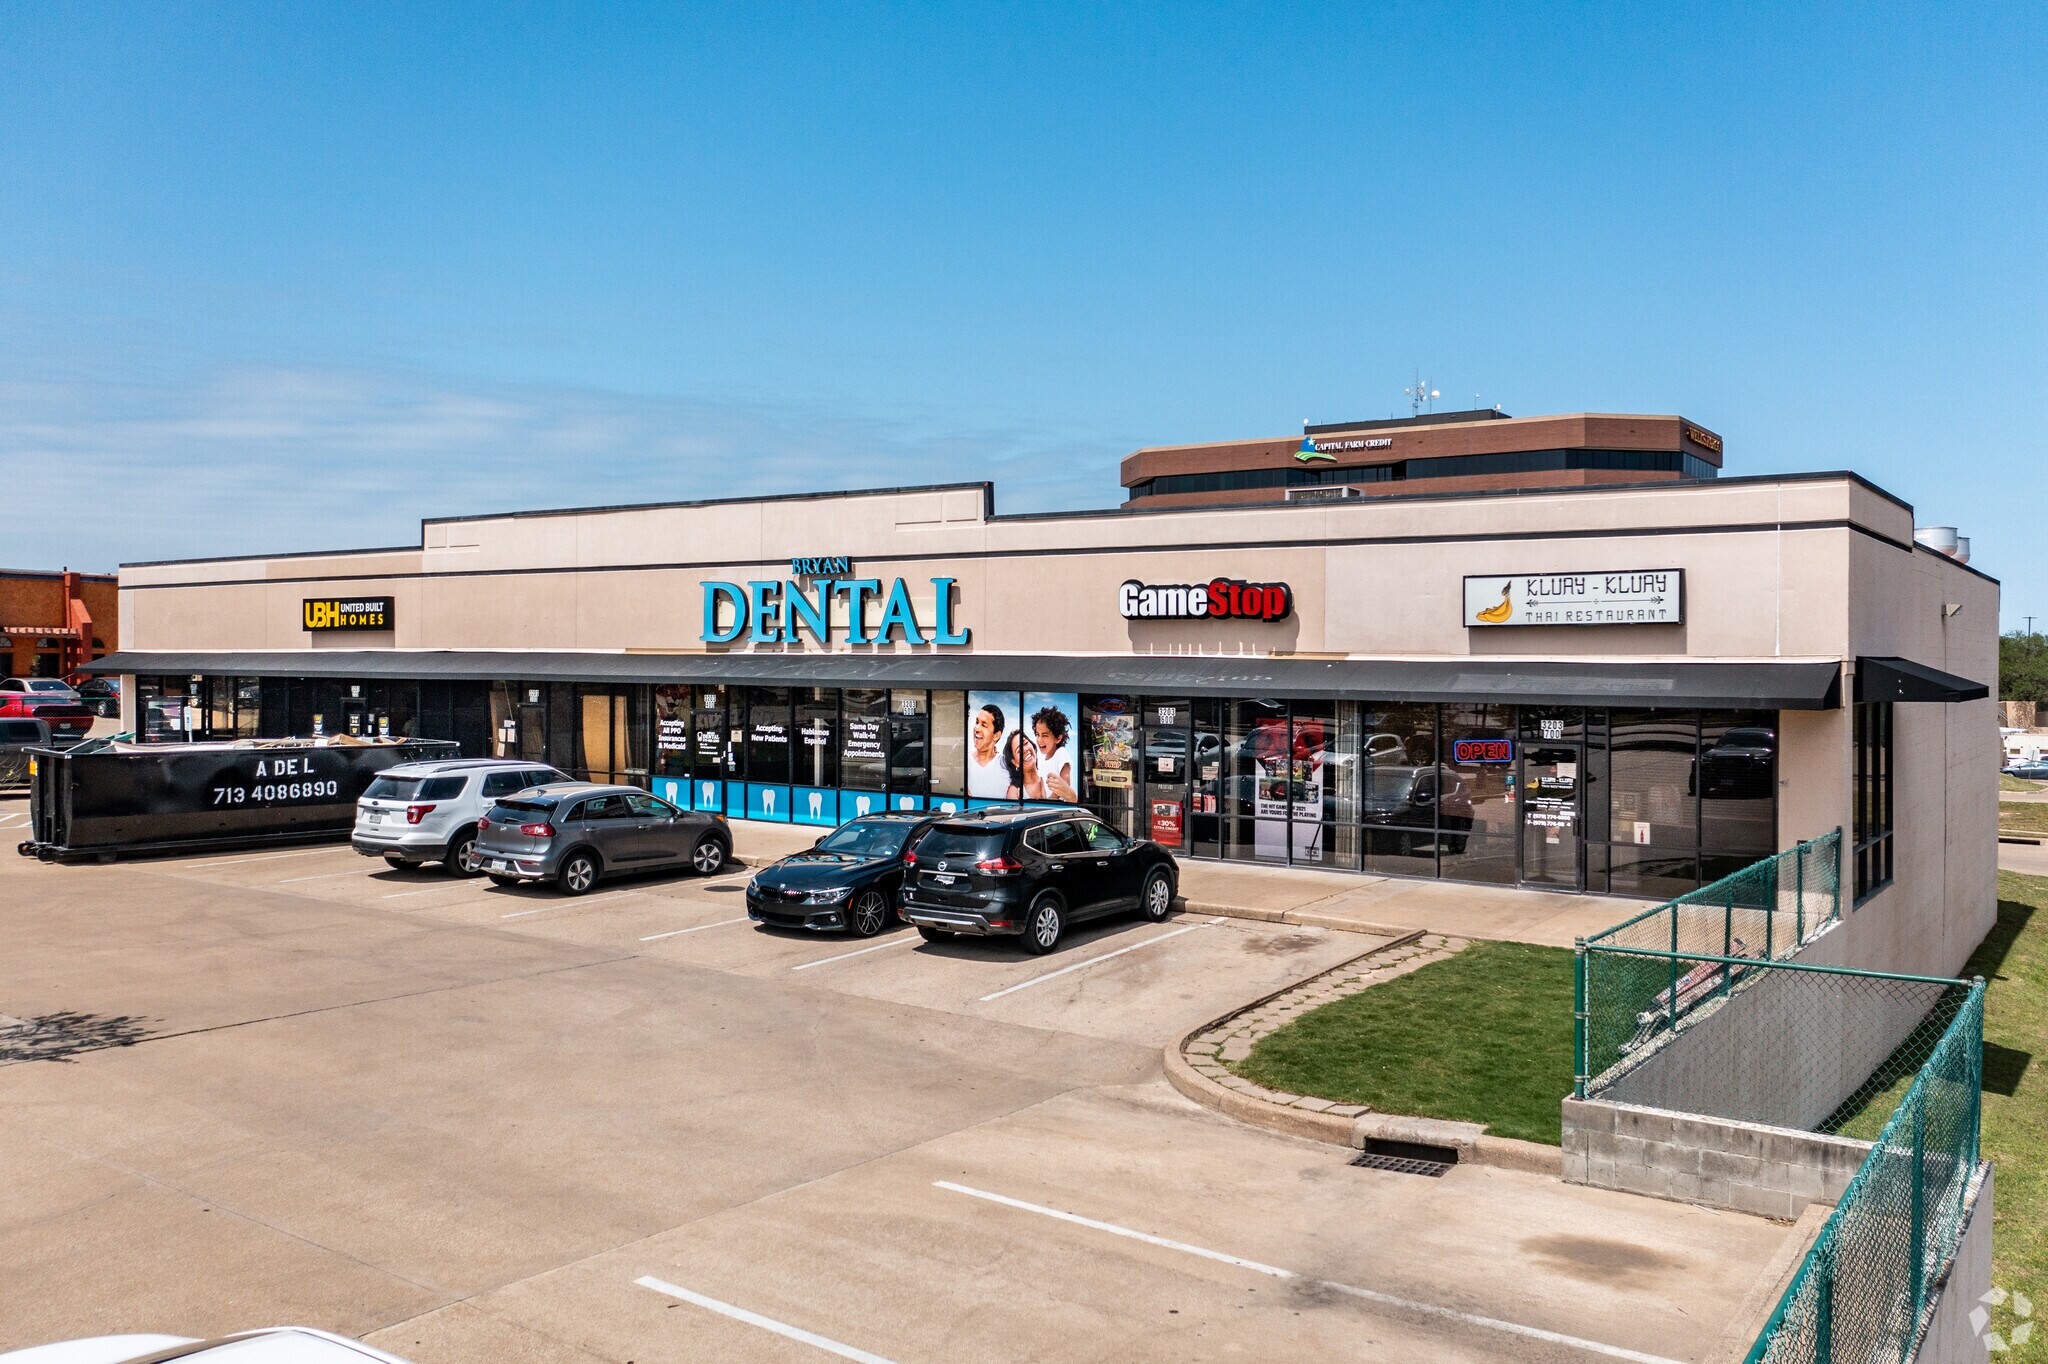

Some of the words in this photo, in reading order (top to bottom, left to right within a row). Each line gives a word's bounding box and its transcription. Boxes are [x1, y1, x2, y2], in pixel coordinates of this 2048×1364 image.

[1315, 442, 1343, 450] CAPITAL
[1345, 440, 1364, 448] FARM
[1365, 438, 1392, 446] CREDIT
[791, 557, 849, 574] BRYAN
[1526, 577, 1585, 596] KLUAY
[1605, 574, 1667, 594] KLUAY
[1119, 580, 1286, 619] GameStop
[341, 603, 365, 612] UNITED
[365, 602, 384, 612] BUILT
[699, 577, 970, 645] DENTAL
[305, 602, 340, 628] UBH
[340, 614, 384, 625] HOMES
[1526, 611, 1559, 622] THAI
[1566, 609, 1667, 621] RESTAURANT
[1158, 707, 1176, 716] 3203
[660, 720, 685, 728] Accepting
[867, 724, 880, 732] Day
[1541, 720, 1564, 730] 3203
[756, 725, 783, 734] Accepting
[801, 728, 829, 737] Hablamos
[1543, 730, 1562, 739] 700
[765, 735, 788, 743] Patients
[804, 738, 827, 746] Español
[848, 740, 880, 750] Emergency
[844, 750, 885, 758] Appointments
[1457, 742, 1510, 760] OPEN
[256, 760, 267, 777] A
[303, 758, 314, 774] L
[213, 787, 245, 805] 713
[251, 780, 337, 801] 4086890
